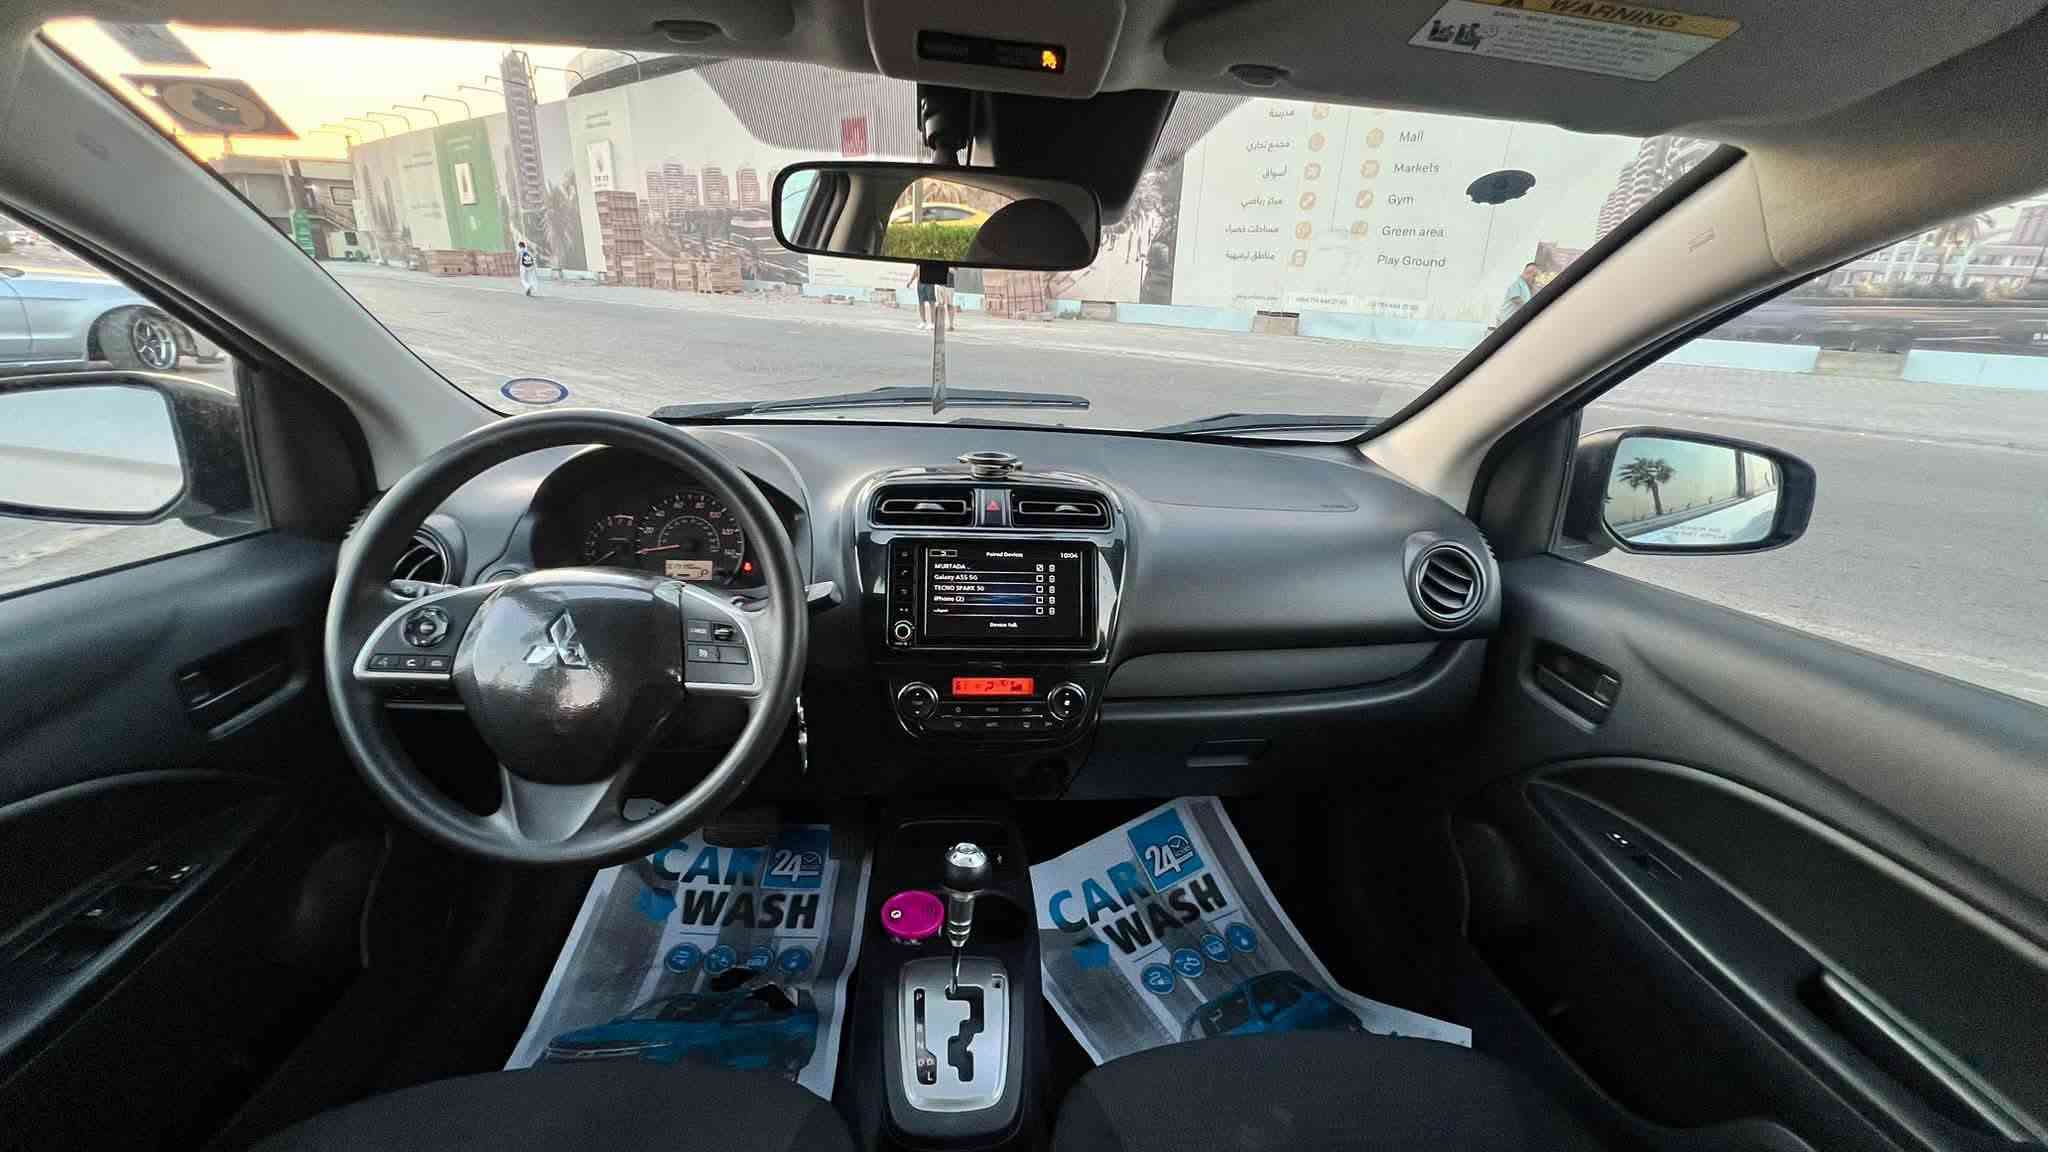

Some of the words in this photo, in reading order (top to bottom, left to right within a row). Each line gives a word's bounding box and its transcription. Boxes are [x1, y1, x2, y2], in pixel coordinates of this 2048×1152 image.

[1549, 0, 1683, 28] WARNING
[1399, 131, 1424, 143] Mall
[1393, 162, 1440, 174] Markets
[1387, 193, 1415, 207] Gym
[1382, 225, 1416, 237] Green
[1418, 228, 1444, 238] area
[1377, 254, 1401, 270] Play
[1402, 255, 1447, 268] Ground
[653, 842, 761, 885] CAR
[771, 851, 800, 882] 24
[1049, 861, 1150, 933] CAR
[682, 889, 820, 930] WASH
[1102, 871, 1228, 956] WASH
